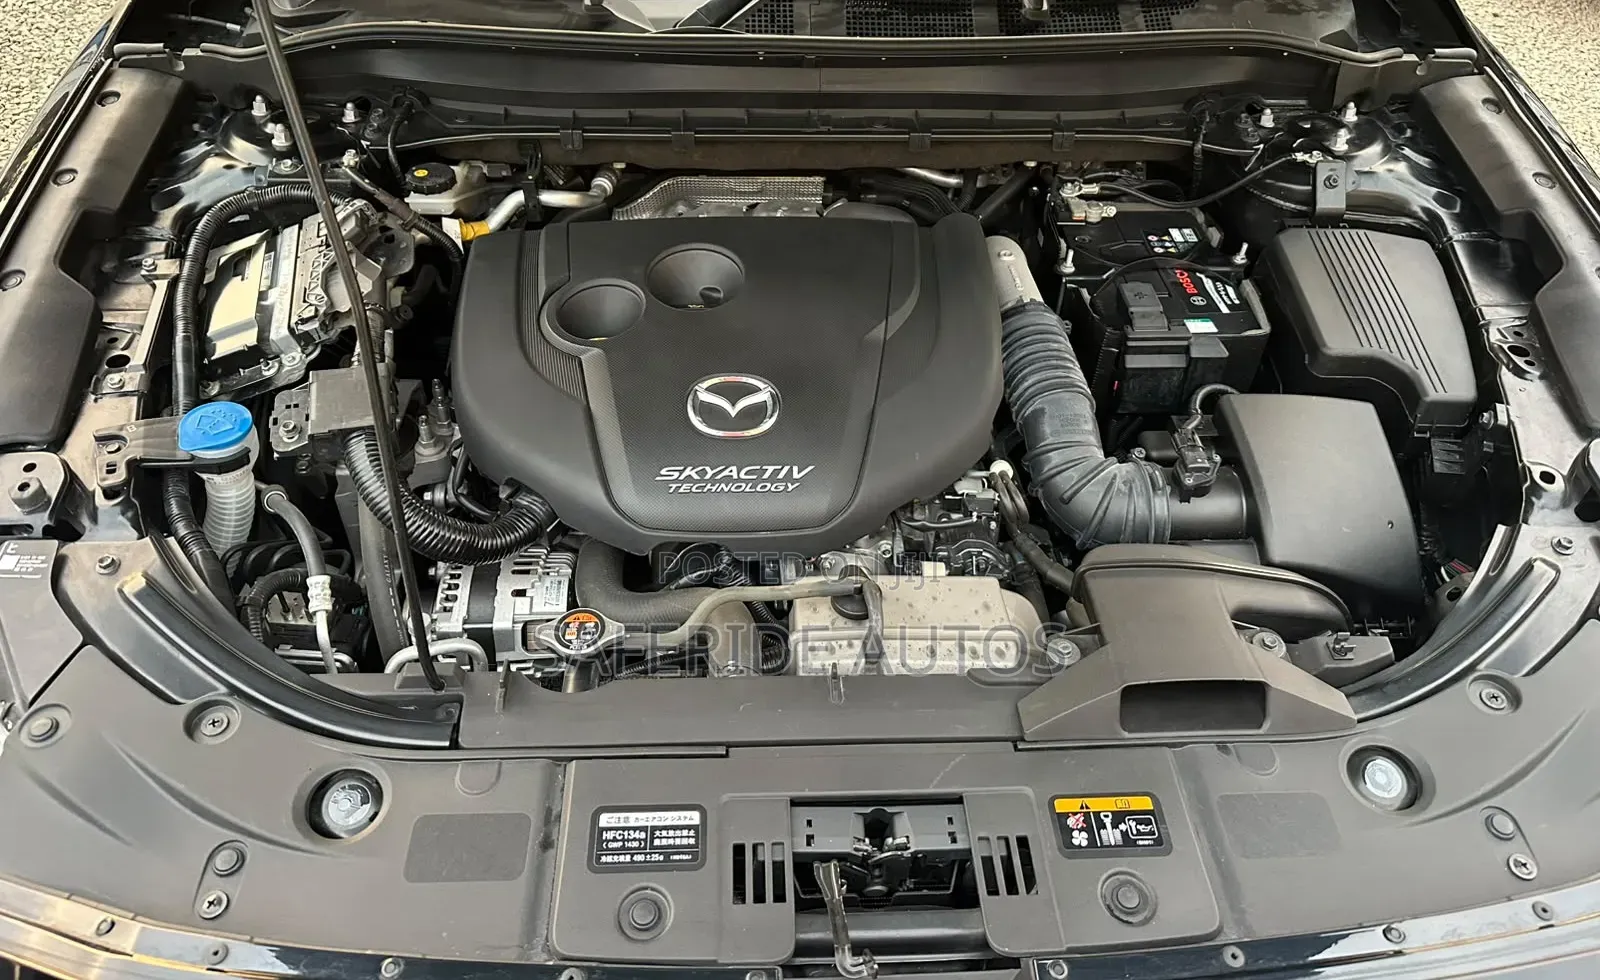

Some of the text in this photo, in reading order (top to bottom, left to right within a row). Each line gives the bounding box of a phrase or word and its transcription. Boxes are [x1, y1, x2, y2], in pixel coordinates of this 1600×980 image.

[655, 465, 816, 481] SKYACTIV
[668, 482, 801, 494] TECHNOLOGY
[602, 830, 646, 840] HFC134a
